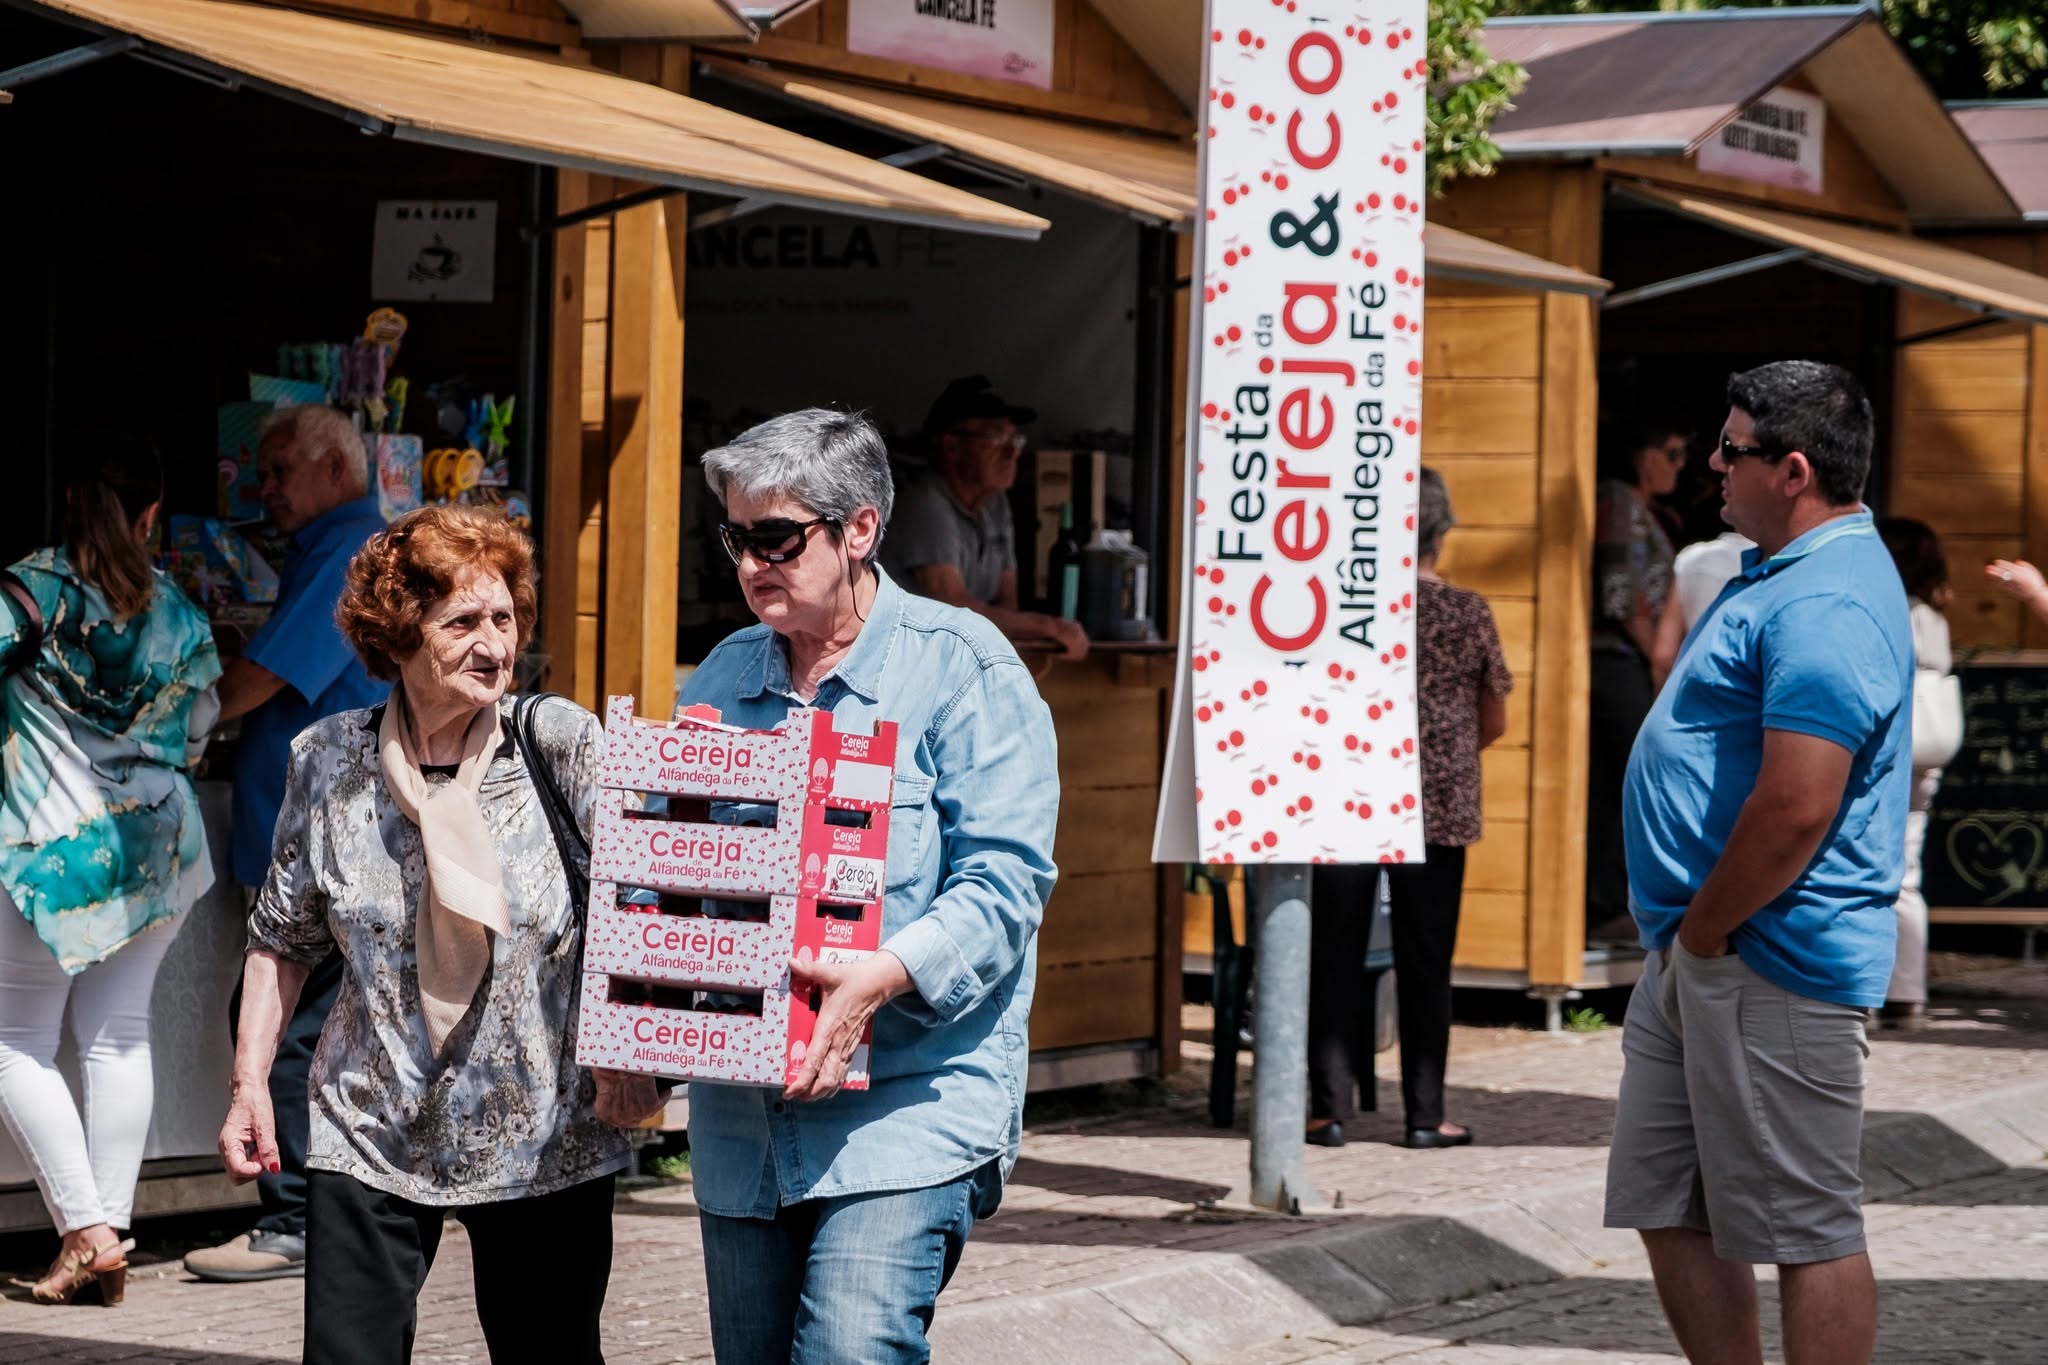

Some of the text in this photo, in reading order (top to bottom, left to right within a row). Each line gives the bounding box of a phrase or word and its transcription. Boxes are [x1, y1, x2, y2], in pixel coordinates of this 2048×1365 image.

[1250, 31, 1356, 652] Cereja & co
[1218, 313, 1273, 561] Festa da
[1336, 281, 1393, 650] Alfândega da Fé
[659, 736, 751, 773] Cereja
[841, 734, 869, 752] Cereja
[657, 767, 750, 786] Alfândega da Fé
[650, 831, 741, 866] Cereja
[833, 828, 861, 847] Cereja
[648, 861, 741, 880] Alfândega da Fé
[836, 859, 874, 891] Cereja
[642, 923, 735, 960] Cereja
[825, 921, 853, 939] Cereja
[640, 953, 733, 974] Alfândega da Fé
[633, 1017, 727, 1054] Cereja
[632, 1047, 725, 1068] Alfândega da Fé
